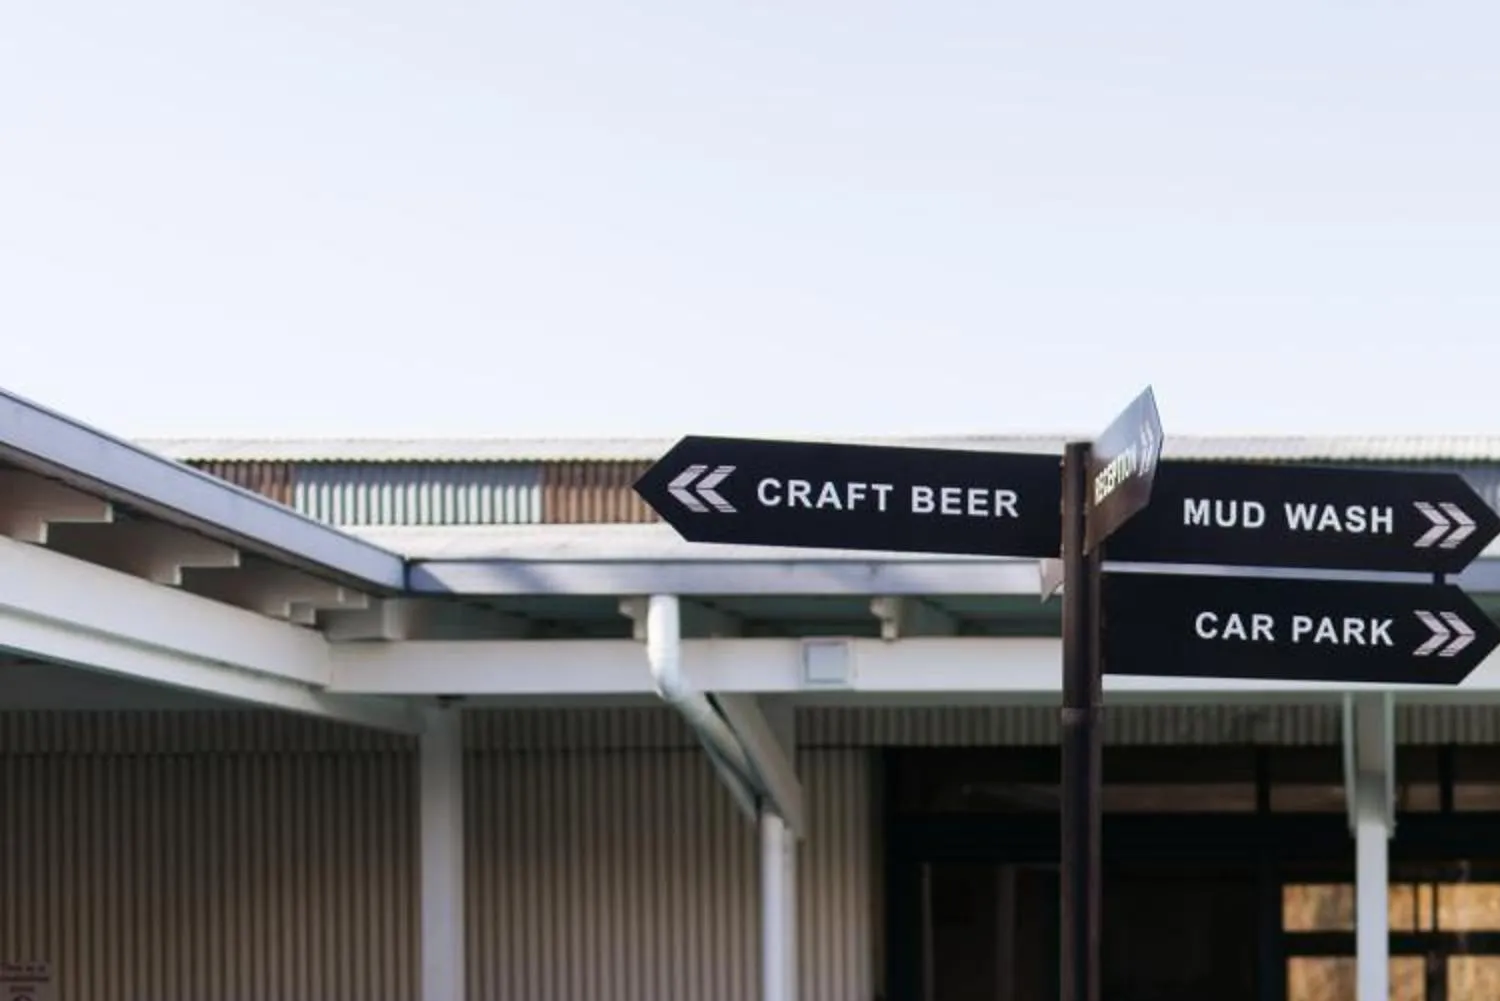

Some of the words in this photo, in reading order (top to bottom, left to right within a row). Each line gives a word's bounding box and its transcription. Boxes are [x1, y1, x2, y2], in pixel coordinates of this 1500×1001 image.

[757, 477, 894, 512] CRAFT
[911, 485, 1019, 518] BEER
[1183, 498, 1266, 529] MUD
[1284, 502, 1393, 534] WASH
[1195, 611, 1275, 642] CAR
[1292, 615, 1394, 646] PARK
